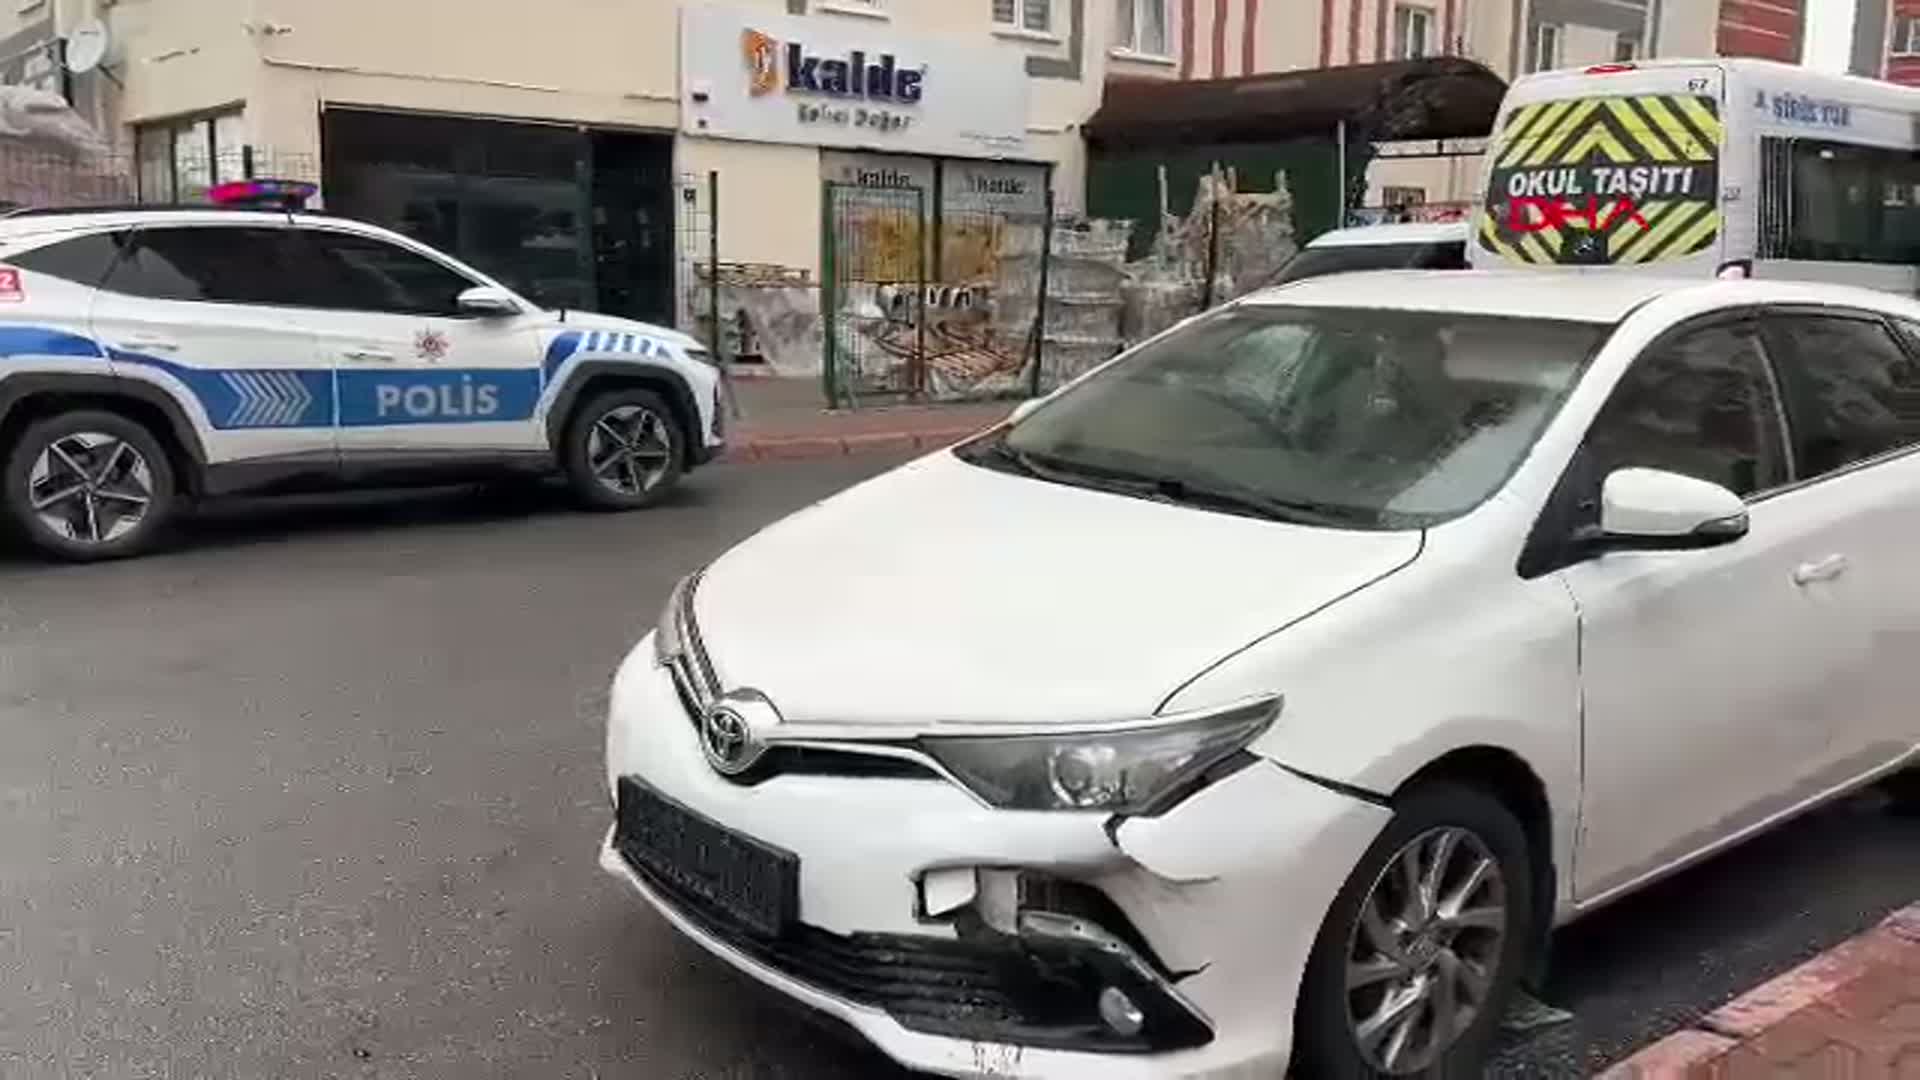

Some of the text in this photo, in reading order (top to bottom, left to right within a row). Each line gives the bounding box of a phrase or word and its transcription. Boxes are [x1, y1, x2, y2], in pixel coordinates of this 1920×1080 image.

[786, 43, 922, 103] kalde
[1688, 79, 1708, 91] 67
[1508, 168, 1583, 197] OKUL
[1591, 167, 1693, 199] TAŞITI
[377, 373, 499, 417] POLİS
